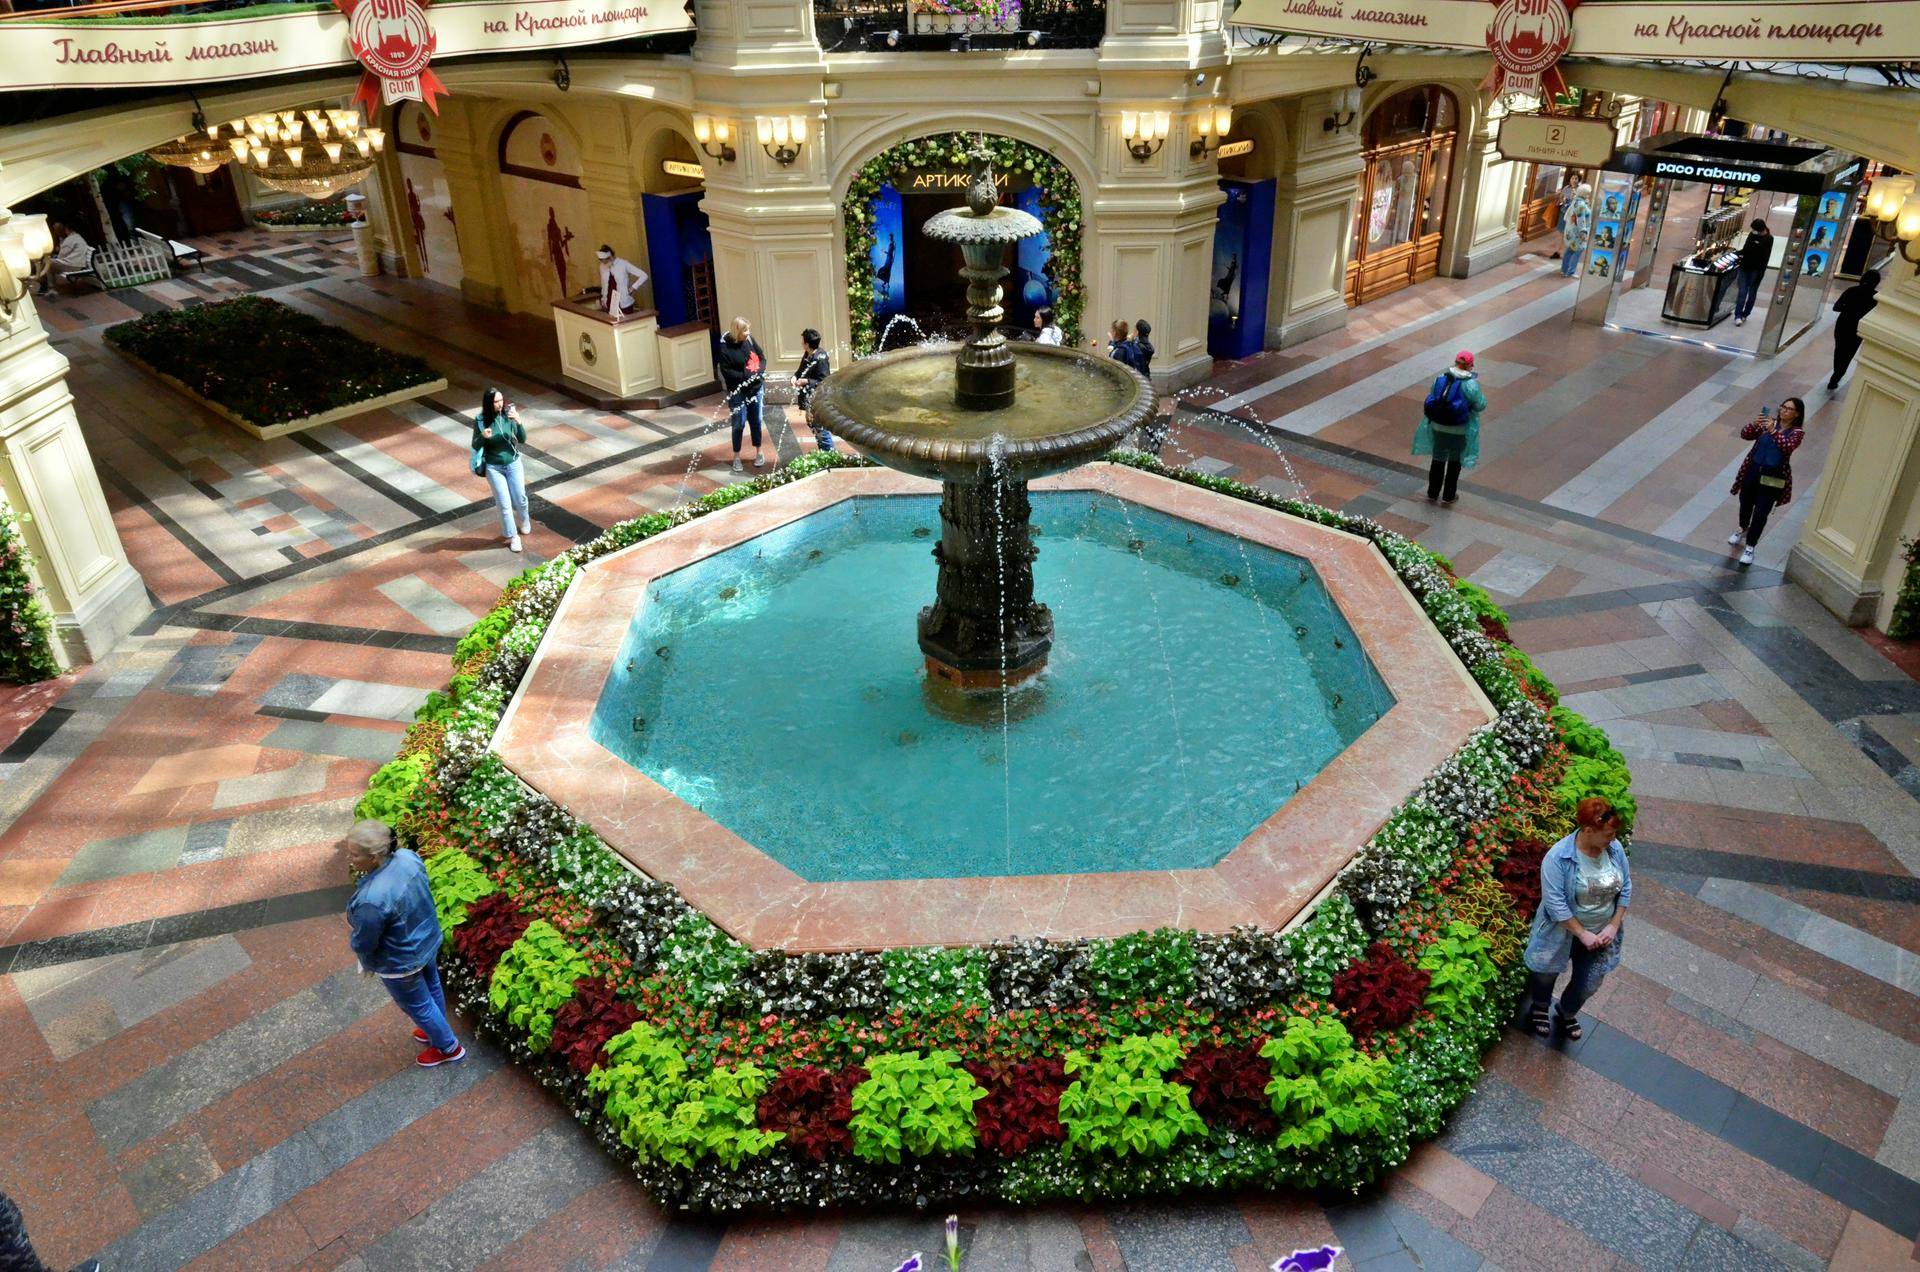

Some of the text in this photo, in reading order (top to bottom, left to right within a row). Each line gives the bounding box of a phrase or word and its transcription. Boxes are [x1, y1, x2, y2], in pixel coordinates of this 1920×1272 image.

[483, 6, 649, 36] на Красной площади
[1351, 8, 1428, 26] магазин
[1634, 15, 1883, 45] на Красной площади
[52, 38, 278, 63] Главный магазин
[1493, 46, 1557, 72] КРАСНАЯ ПЛОЩАДЬ
[365, 50, 430, 77] КРАСНАЯ ПЛОЩАДЬ
[388, 80, 415, 94] GUM
[1508, 75, 1535, 89] GUM
[1551, 128, 1561, 141] 2
[1561, 149, 1580, 158] LINE
[912, 173, 1008, 188] АРТИКИ
[1656, 161, 1761, 183] paco rabanne
